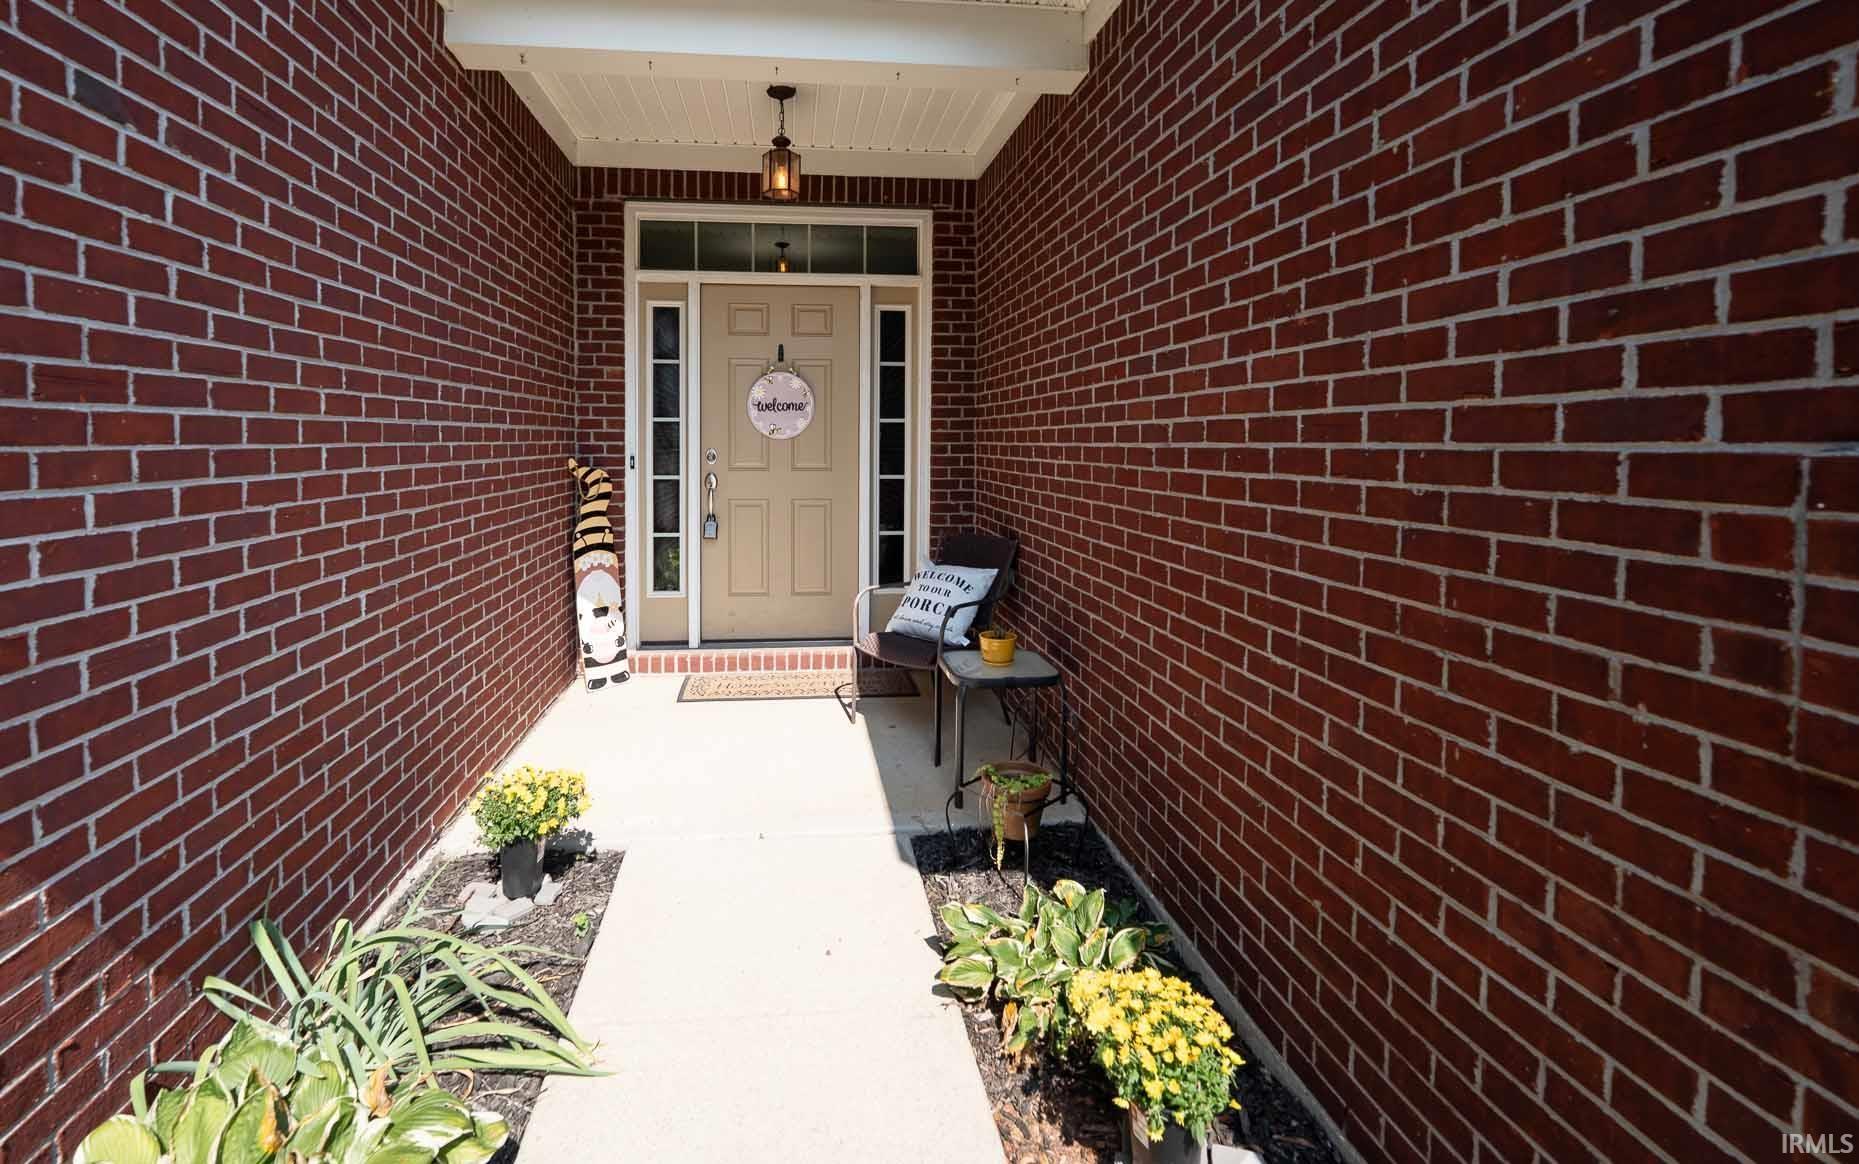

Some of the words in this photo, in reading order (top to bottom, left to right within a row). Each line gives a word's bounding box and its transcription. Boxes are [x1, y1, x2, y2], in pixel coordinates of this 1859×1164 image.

[752, 398, 809, 413] welcome
[914, 570, 974, 594] WELCOME
[918, 584, 929, 592] TO
[930, 586, 952, 597] OUR
[901, 596, 949, 615] PORC
